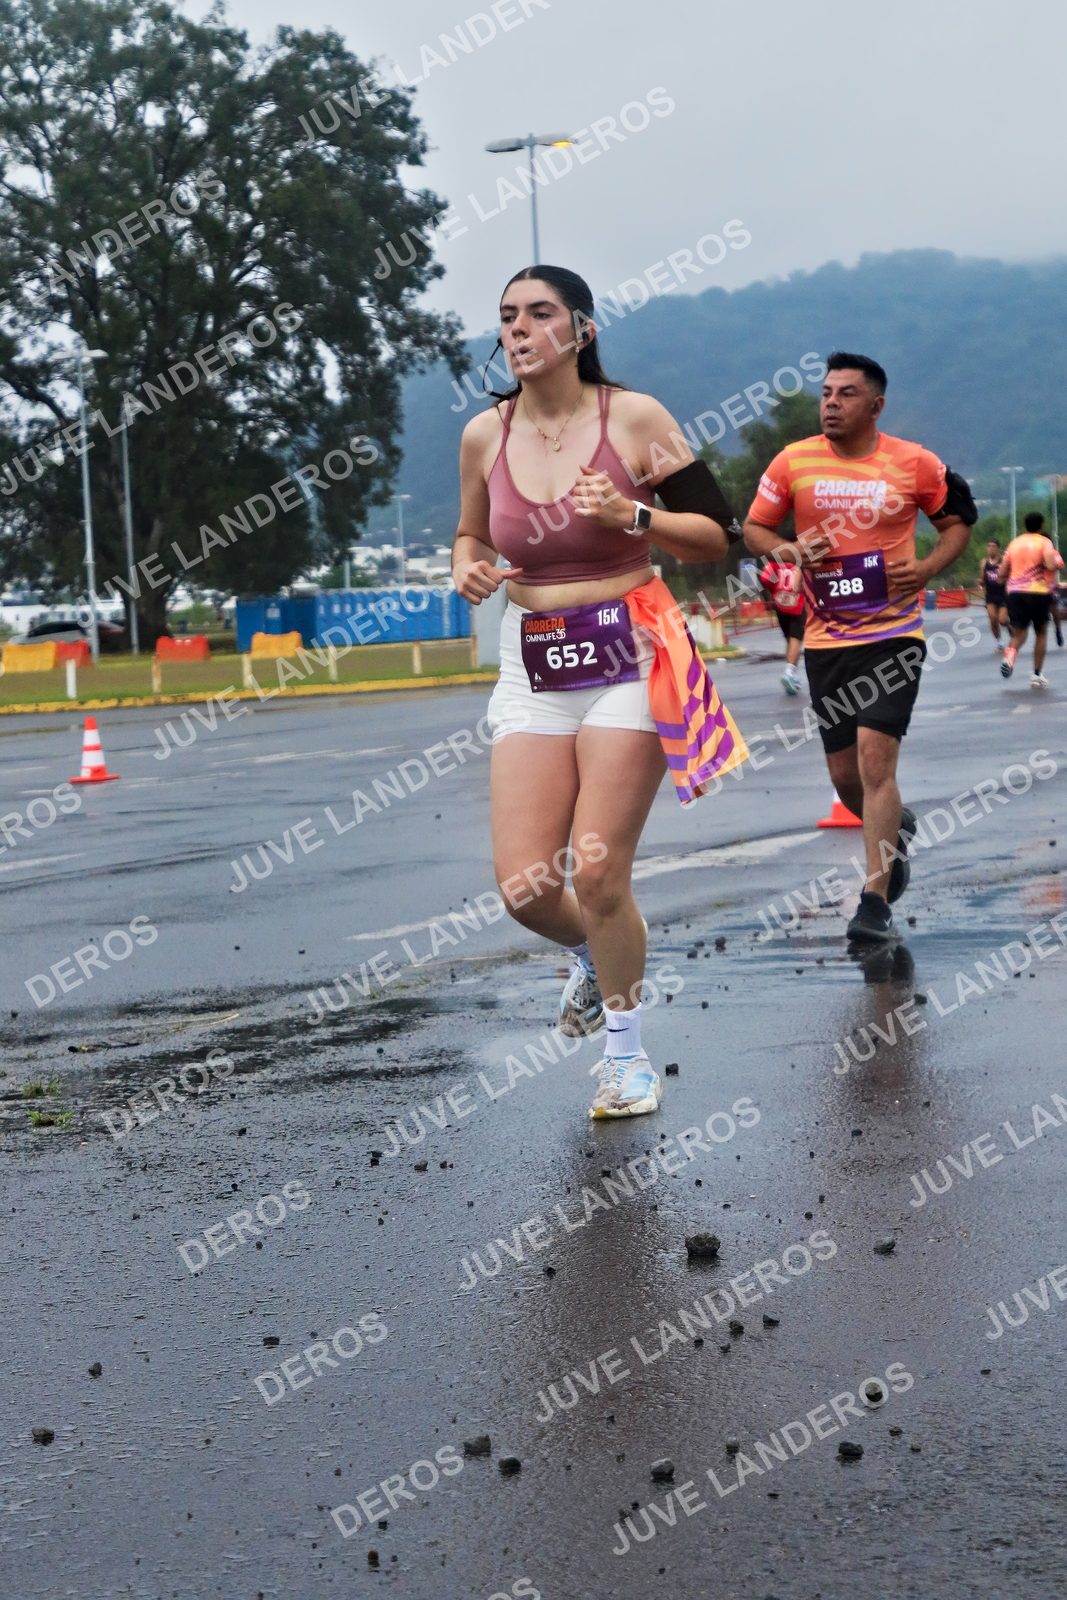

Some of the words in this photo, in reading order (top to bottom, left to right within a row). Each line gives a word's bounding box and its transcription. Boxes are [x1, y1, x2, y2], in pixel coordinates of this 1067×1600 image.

[814, 479, 887, 496] CARRERA
[863, 555, 879, 568] 15K
[828, 577, 864, 597] 288
[525, 617, 565, 633] CARRERA
[597, 607, 620, 626] 15K
[526, 632, 556, 642] OMNILIFE
[546, 641, 598, 670] 652
